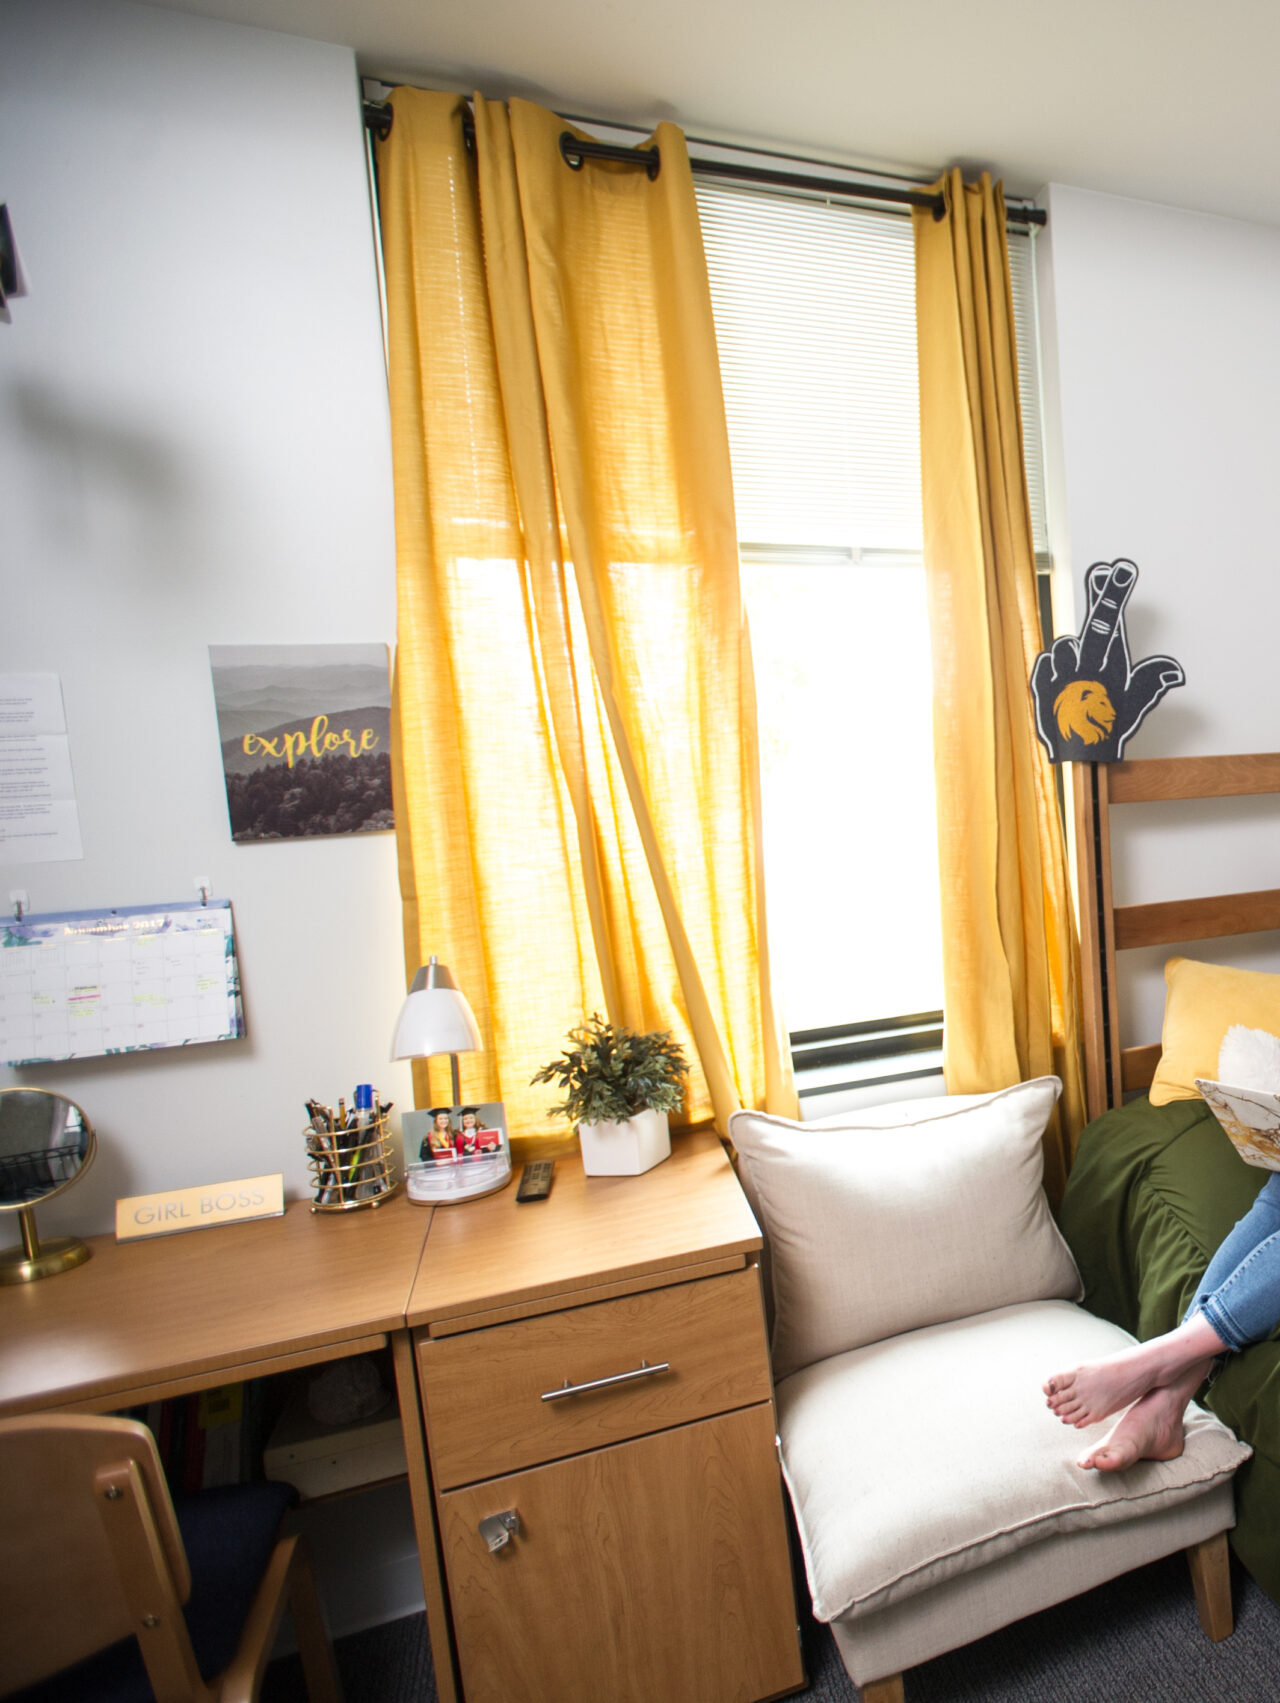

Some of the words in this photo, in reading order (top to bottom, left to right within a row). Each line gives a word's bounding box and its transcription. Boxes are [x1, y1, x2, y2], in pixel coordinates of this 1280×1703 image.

[242, 715, 380, 769] explore
[134, 1200, 191, 1225] GIRL
[200, 1187, 266, 1215] BOSS
